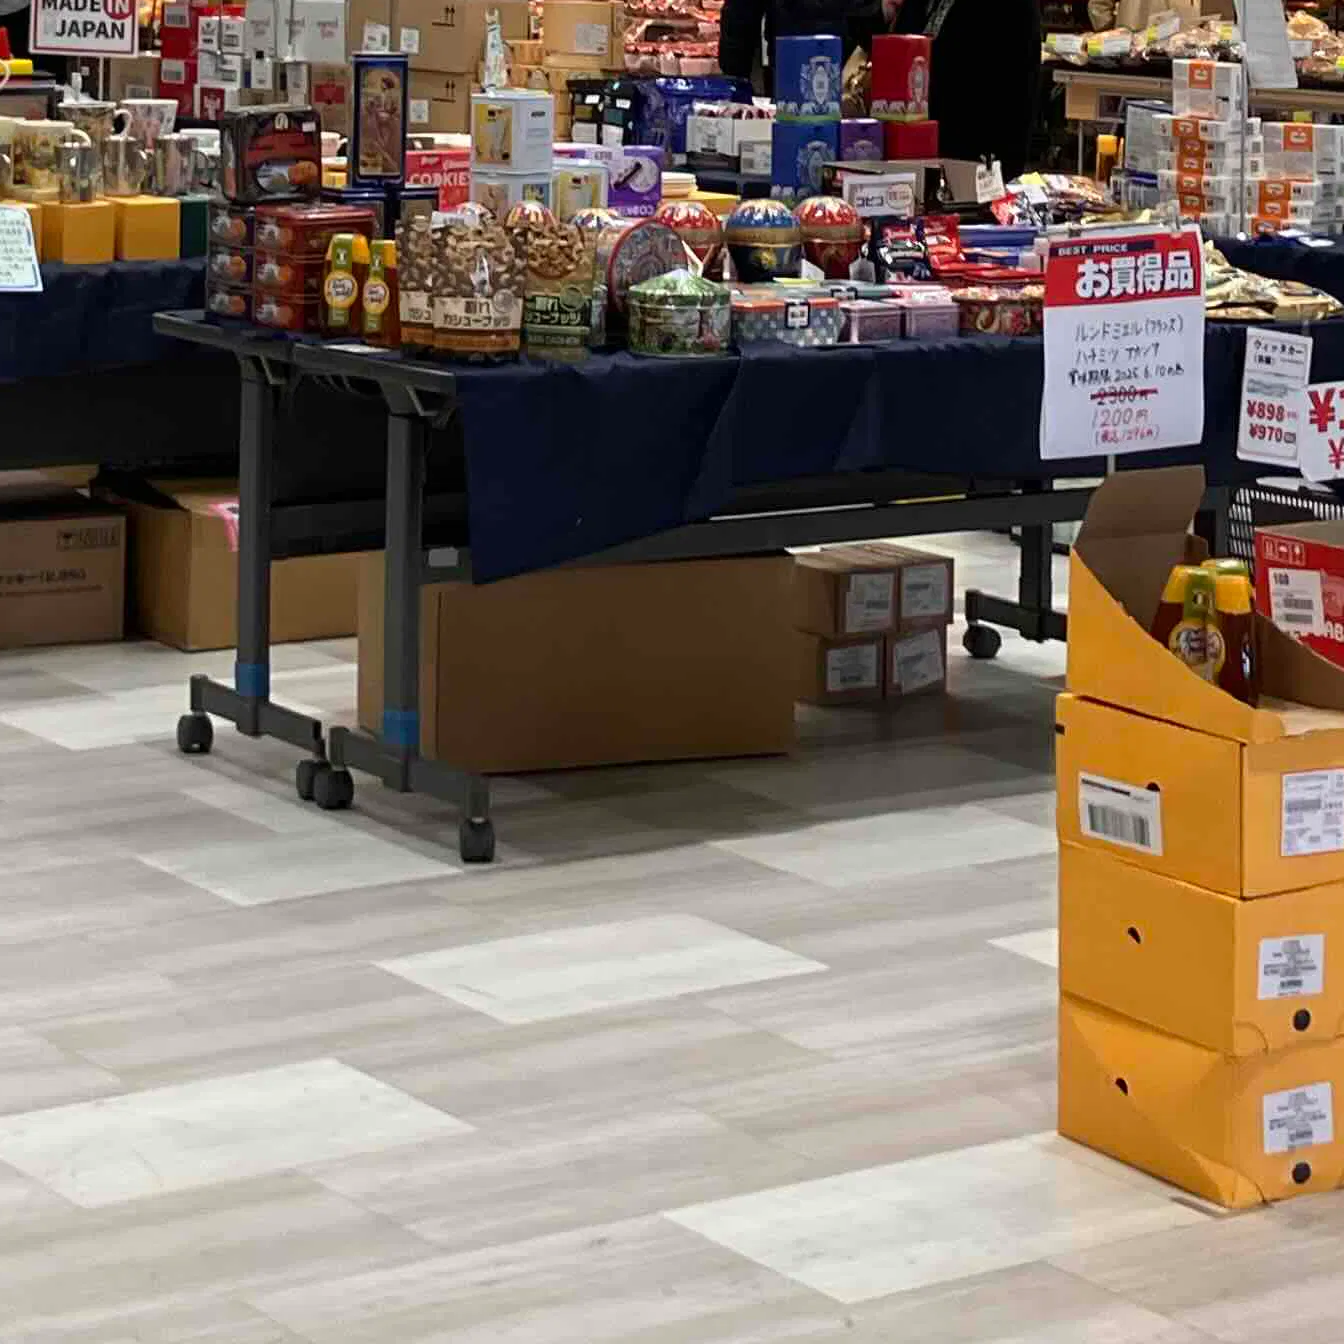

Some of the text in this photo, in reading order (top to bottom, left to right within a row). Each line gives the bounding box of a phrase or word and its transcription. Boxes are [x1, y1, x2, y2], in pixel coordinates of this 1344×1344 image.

[56, 19, 125, 39] JAPAN
[1058, 243, 1129, 257] BEST PRICE
[1075, 249, 1195, 299] お買得品
[1246, 399, 1286, 422] ¥898
[1248, 423, 1283, 443] ¥970
